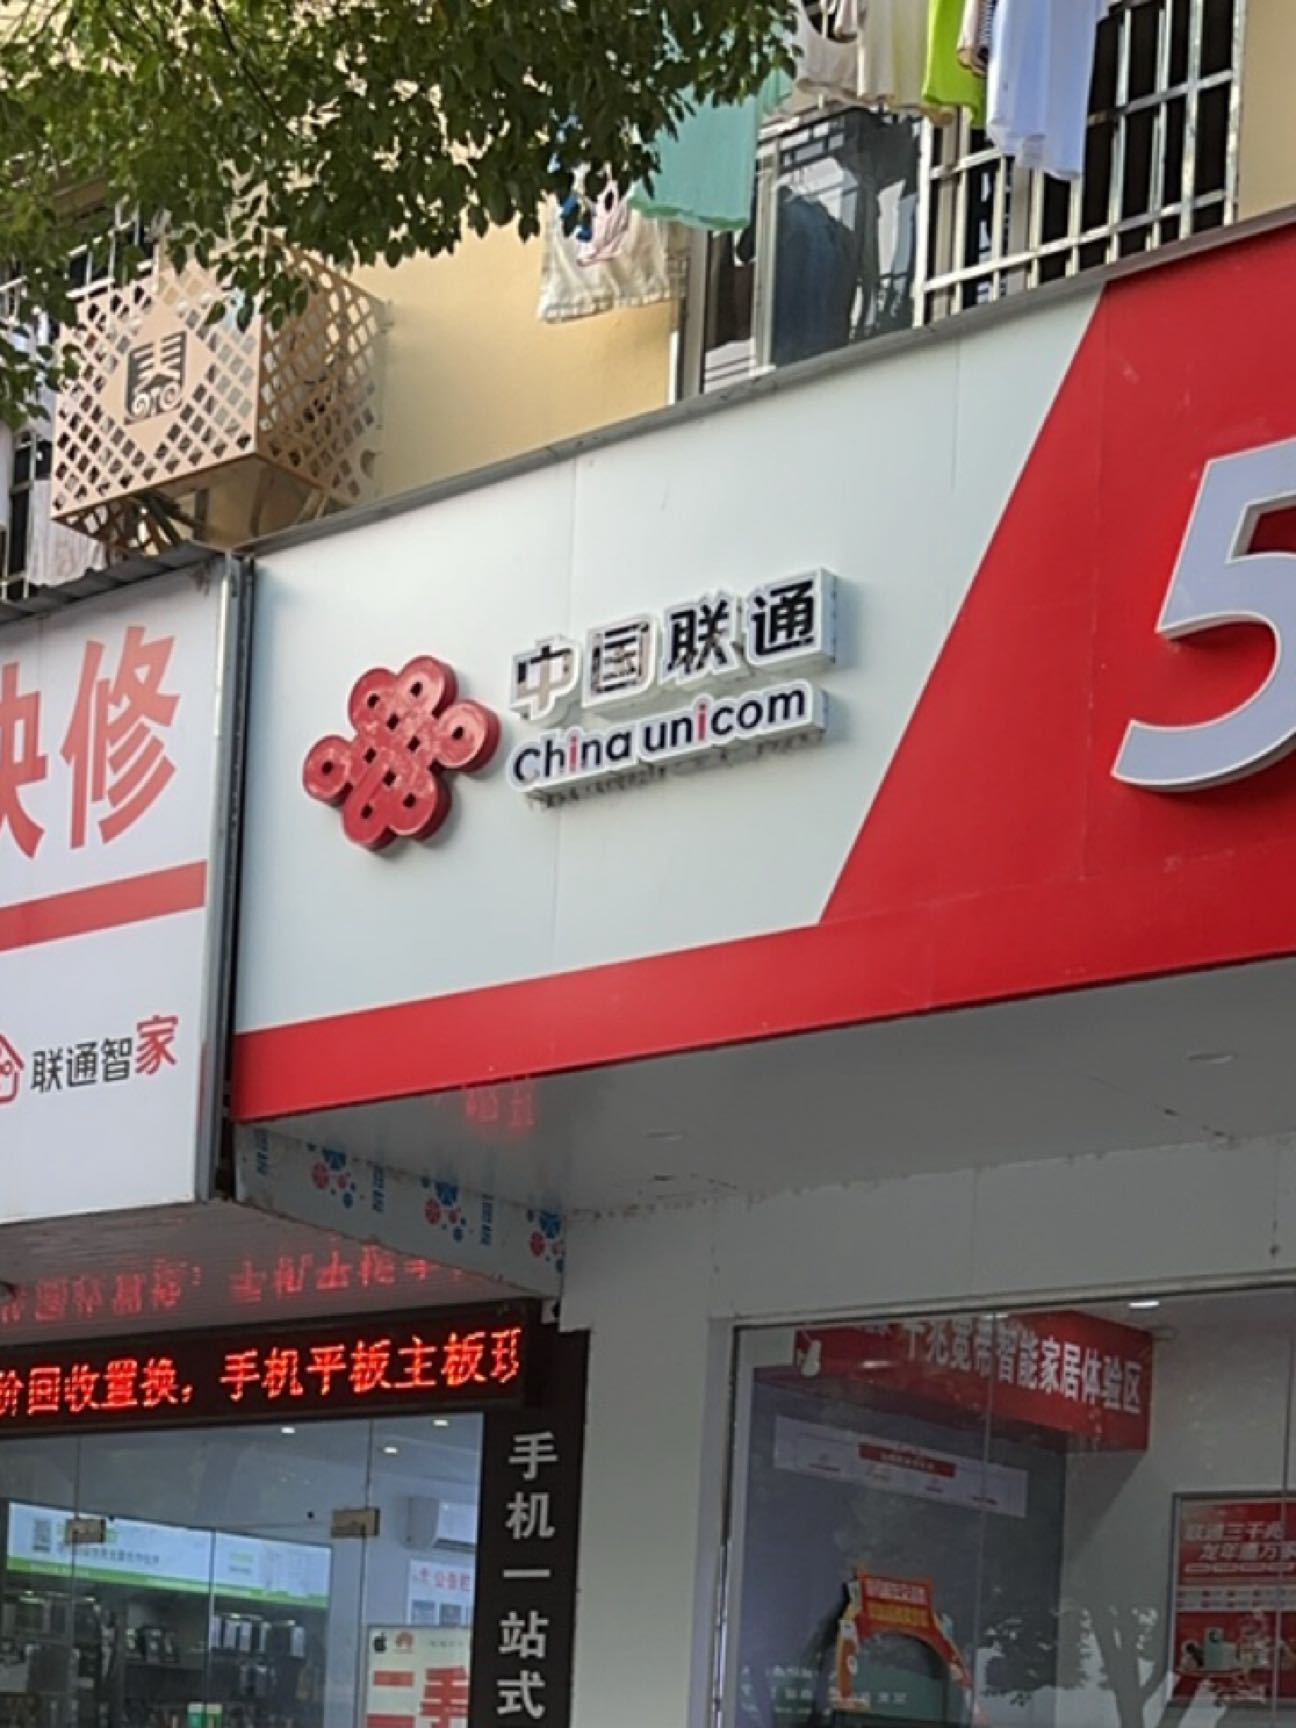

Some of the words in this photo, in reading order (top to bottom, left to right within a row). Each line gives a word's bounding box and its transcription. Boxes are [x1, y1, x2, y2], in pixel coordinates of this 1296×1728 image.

[513, 577, 821, 715] 中国联通
[511, 728, 633, 786] China
[641, 683, 809, 757] unicom
[29, 1013, 180, 1095] 联通智家
